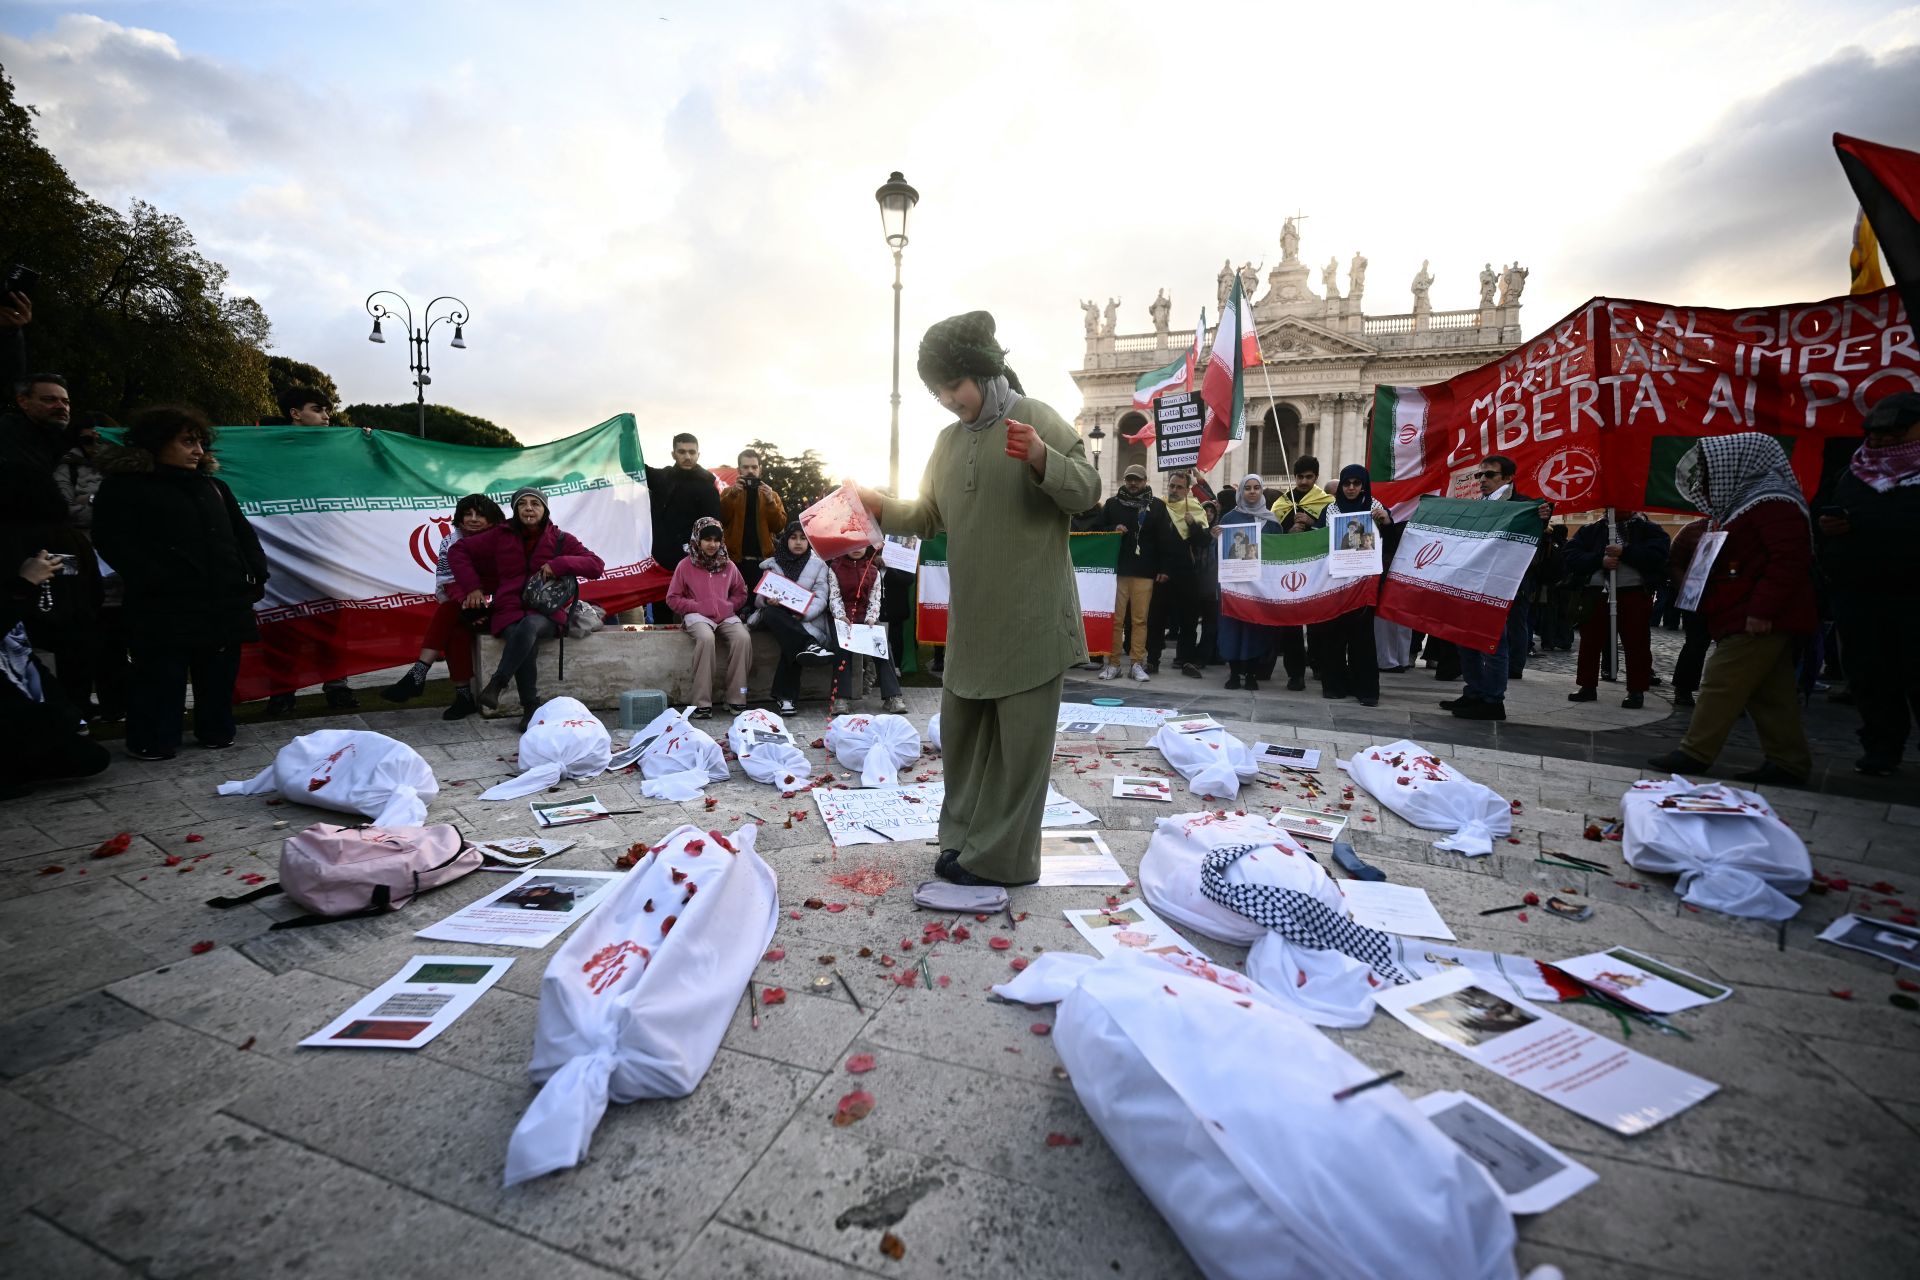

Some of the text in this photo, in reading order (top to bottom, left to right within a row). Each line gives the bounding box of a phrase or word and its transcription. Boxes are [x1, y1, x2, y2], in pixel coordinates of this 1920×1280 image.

[1499, 299, 1637, 386] MORTE
[1652, 308, 1713, 338] AL
[1470, 345, 1591, 424] MORTE
[1735, 324, 1920, 376] IMPER
[1702, 372, 1757, 427] AI
[1158, 405, 1197, 418] Lotta con
[1162, 420, 1201, 433] l'oppresso
